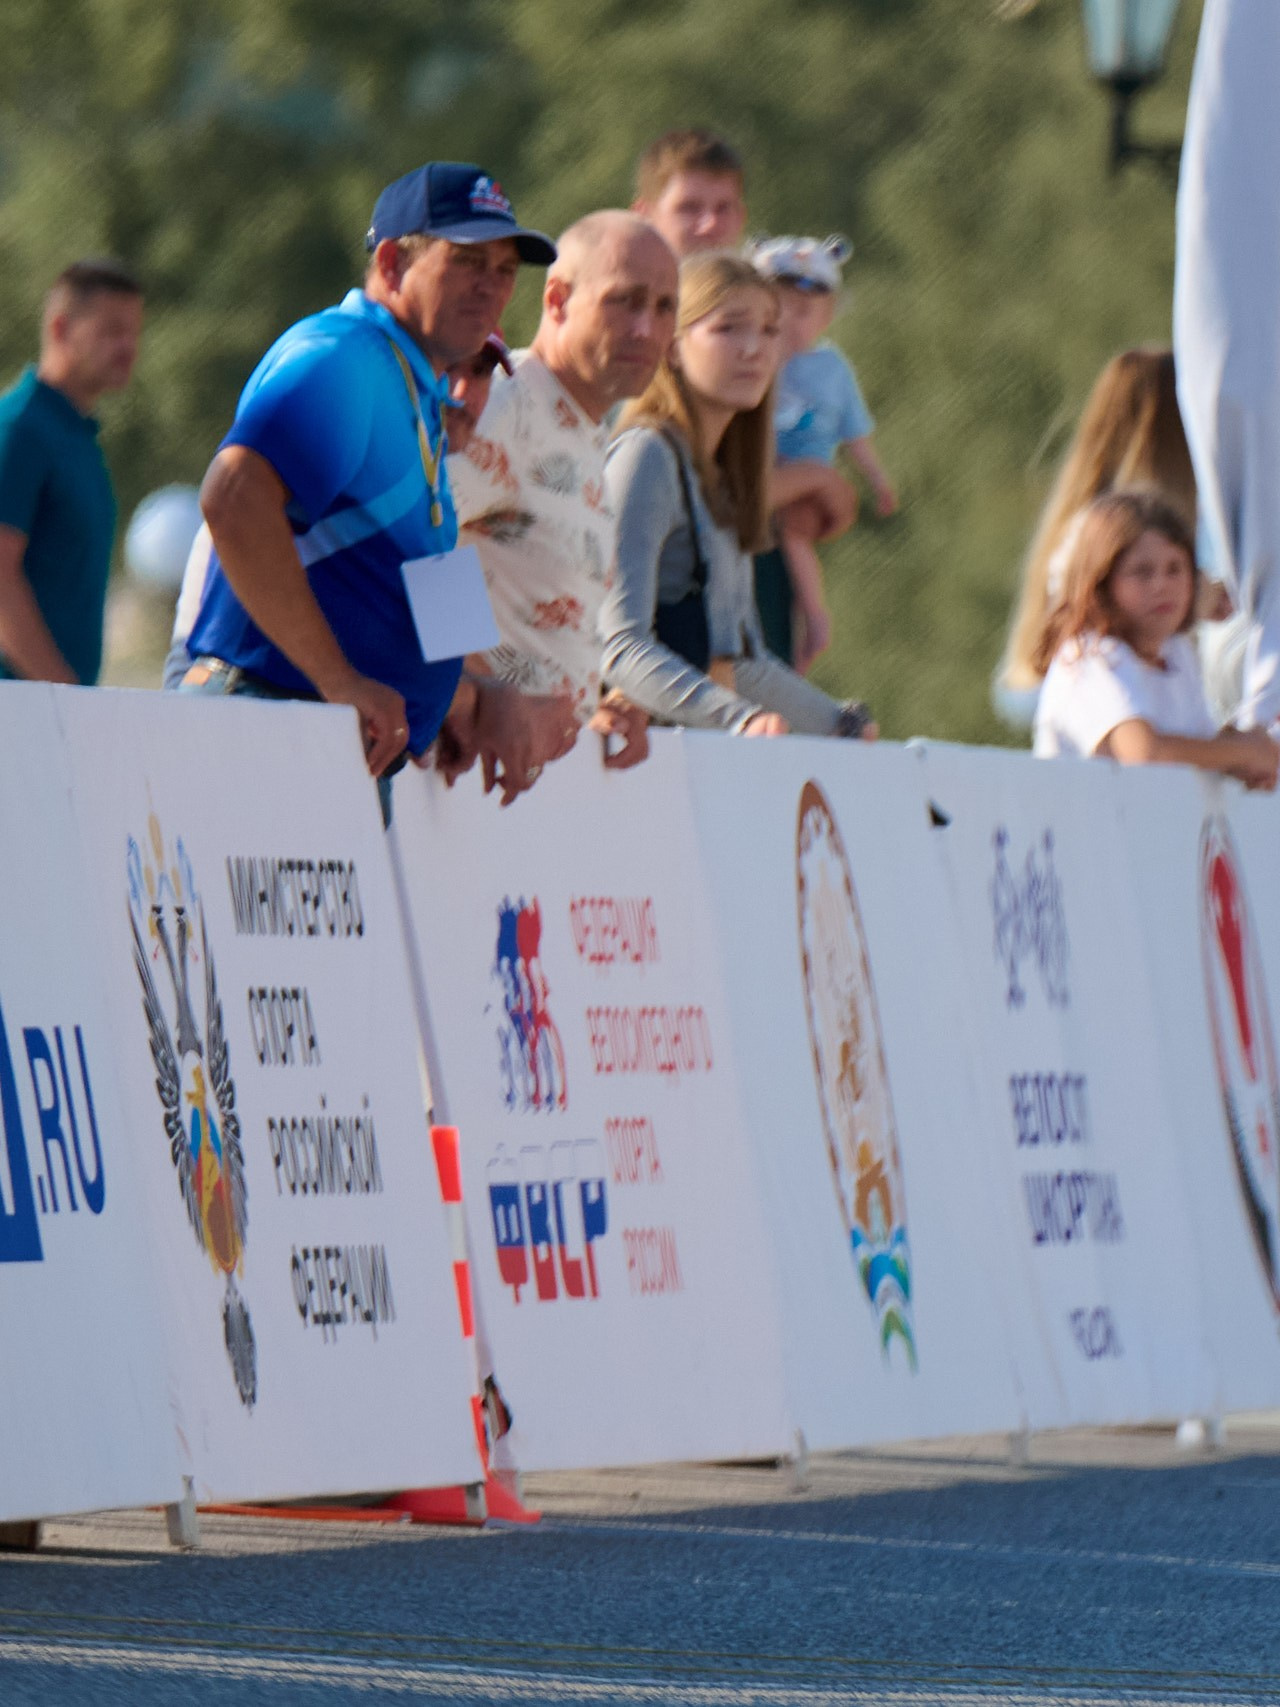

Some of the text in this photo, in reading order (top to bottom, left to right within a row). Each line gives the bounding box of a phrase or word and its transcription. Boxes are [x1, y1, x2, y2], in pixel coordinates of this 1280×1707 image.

[226, 855, 364, 938] МИНИСТЕРСТВО
[248, 985, 321, 1067] СПОРТА
[268, 1093, 384, 1195] РОССИЙСКОЙ
[291, 1245, 396, 1344] ФЕДЕРАЦИИ
